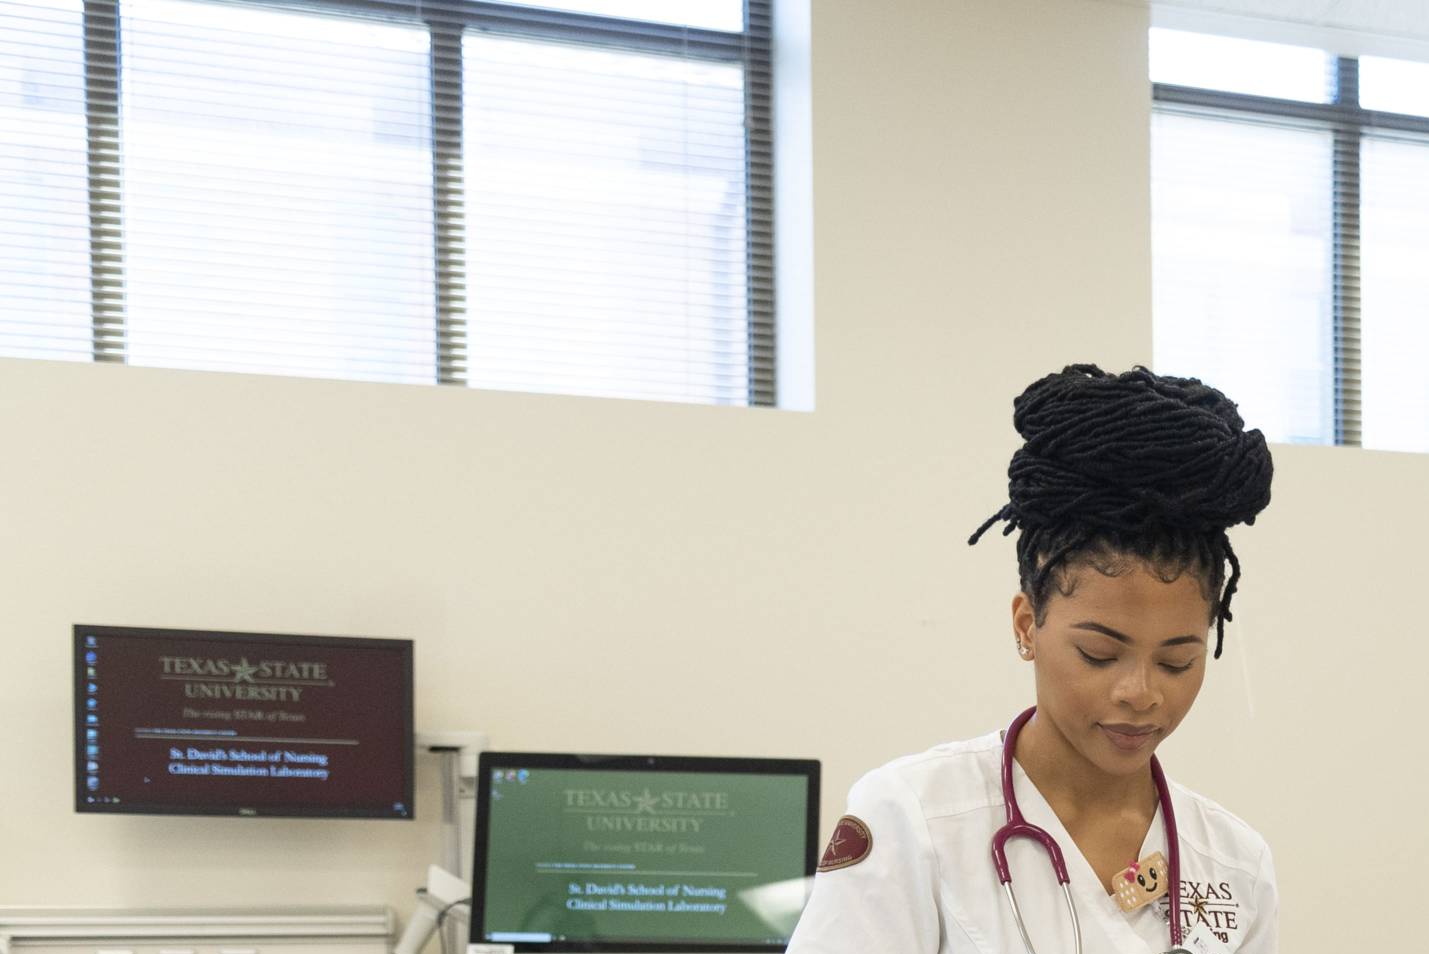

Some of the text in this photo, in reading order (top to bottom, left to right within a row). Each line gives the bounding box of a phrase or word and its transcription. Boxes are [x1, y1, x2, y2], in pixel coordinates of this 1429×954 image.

[159, 656, 328, 680] TEXAS STATE
[184, 683, 303, 701] UNIVERSITY
[169, 747, 184, 760] St.
[228, 749, 267, 762] School
[268, 751, 281, 762] of
[284, 751, 329, 766] Nursing
[168, 762, 329, 781] Clinical Simulation Laboratory
[564, 789, 728, 809] TEXAS STATE
[587, 816, 703, 832] UNIVERSITY
[569, 883, 583, 895] St.
[626, 884, 664, 896] School
[666, 884, 680, 896] of
[683, 885, 727, 900] Nursing
[1179, 880, 1232, 900] EXAS
[566, 898, 727, 914] Clinical Simulation Laboratory
